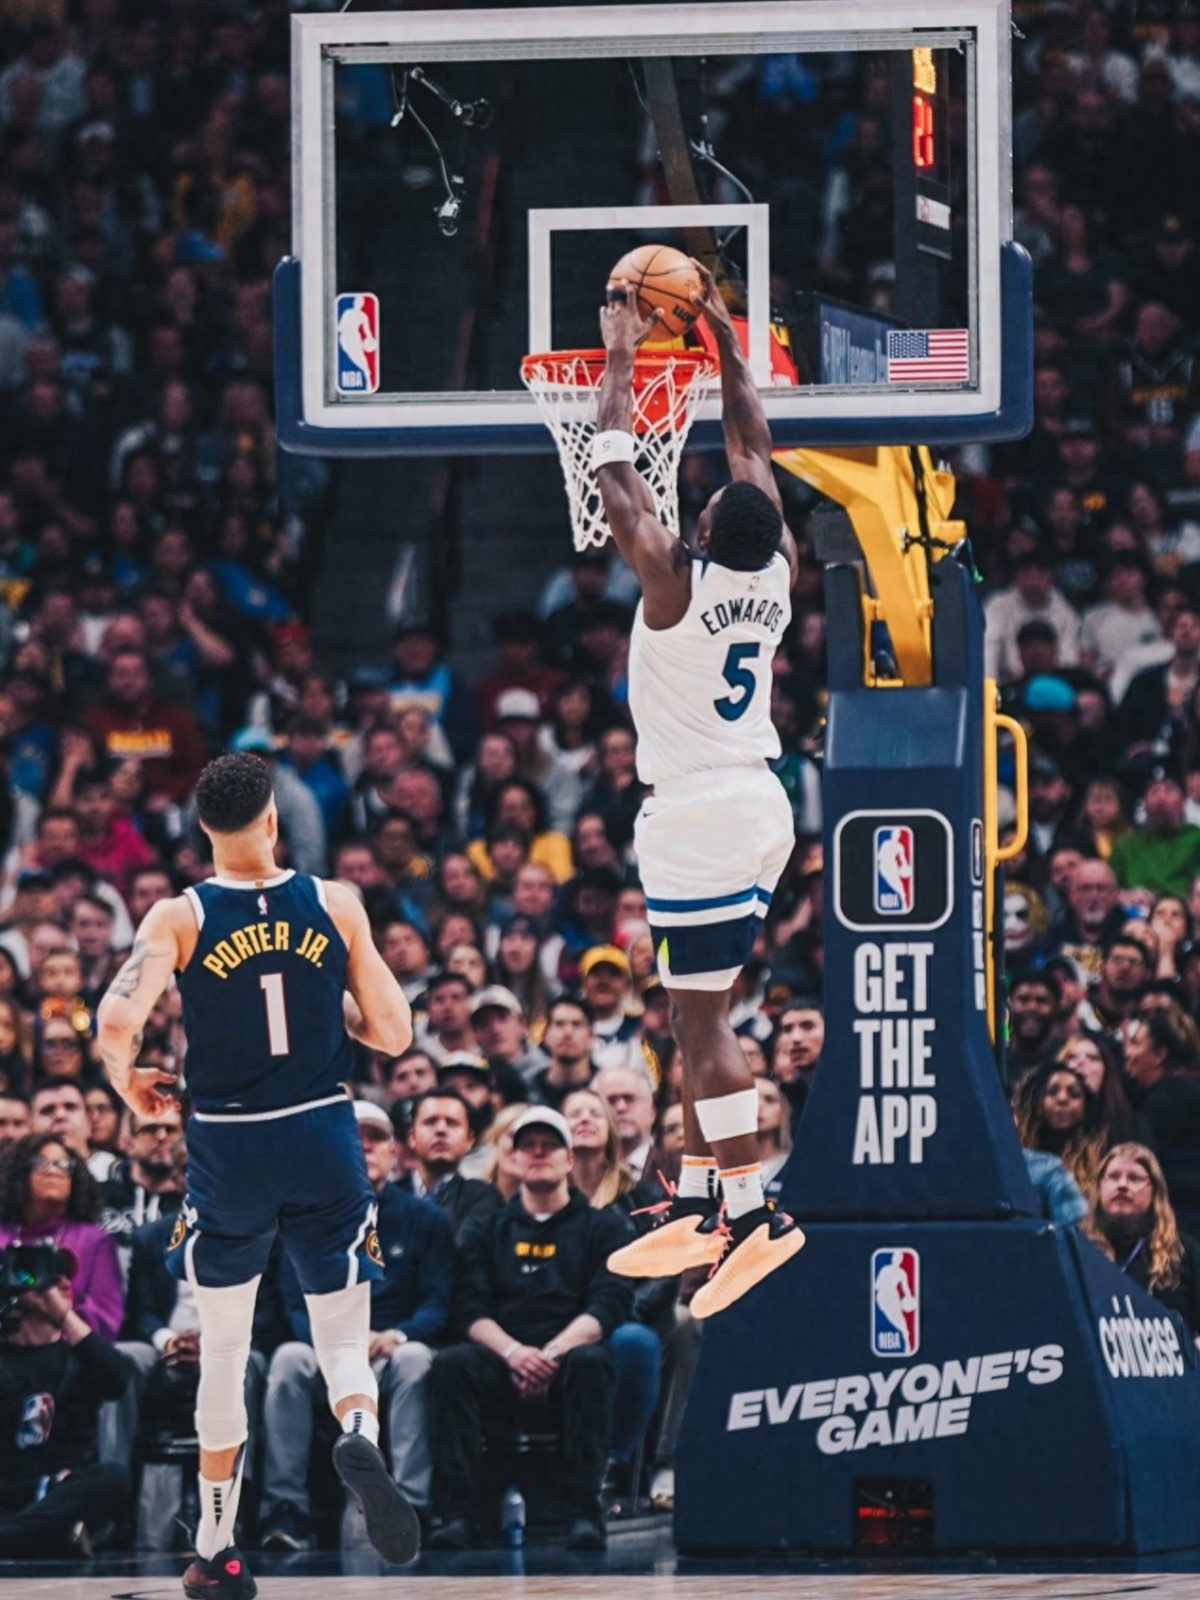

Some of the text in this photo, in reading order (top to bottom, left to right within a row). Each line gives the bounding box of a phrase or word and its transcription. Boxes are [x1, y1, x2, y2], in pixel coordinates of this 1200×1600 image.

[342, 370, 363, 387] NBA
[700, 597, 783, 636] EDWARDS
[713, 641, 760, 721] 5
[203, 921, 329, 979] PORTER JR.
[854, 942, 934, 1013] GET
[260, 973, 289, 1056] 1
[853, 1018, 936, 1088] THE
[852, 1094, 937, 1164] APP
[879, 1331, 901, 1350] NBA
[1099, 1294, 1184, 1378] coinbase
[726, 1344, 1065, 1432] EVERYONE'S
[816, 1396, 972, 1455] GAME
